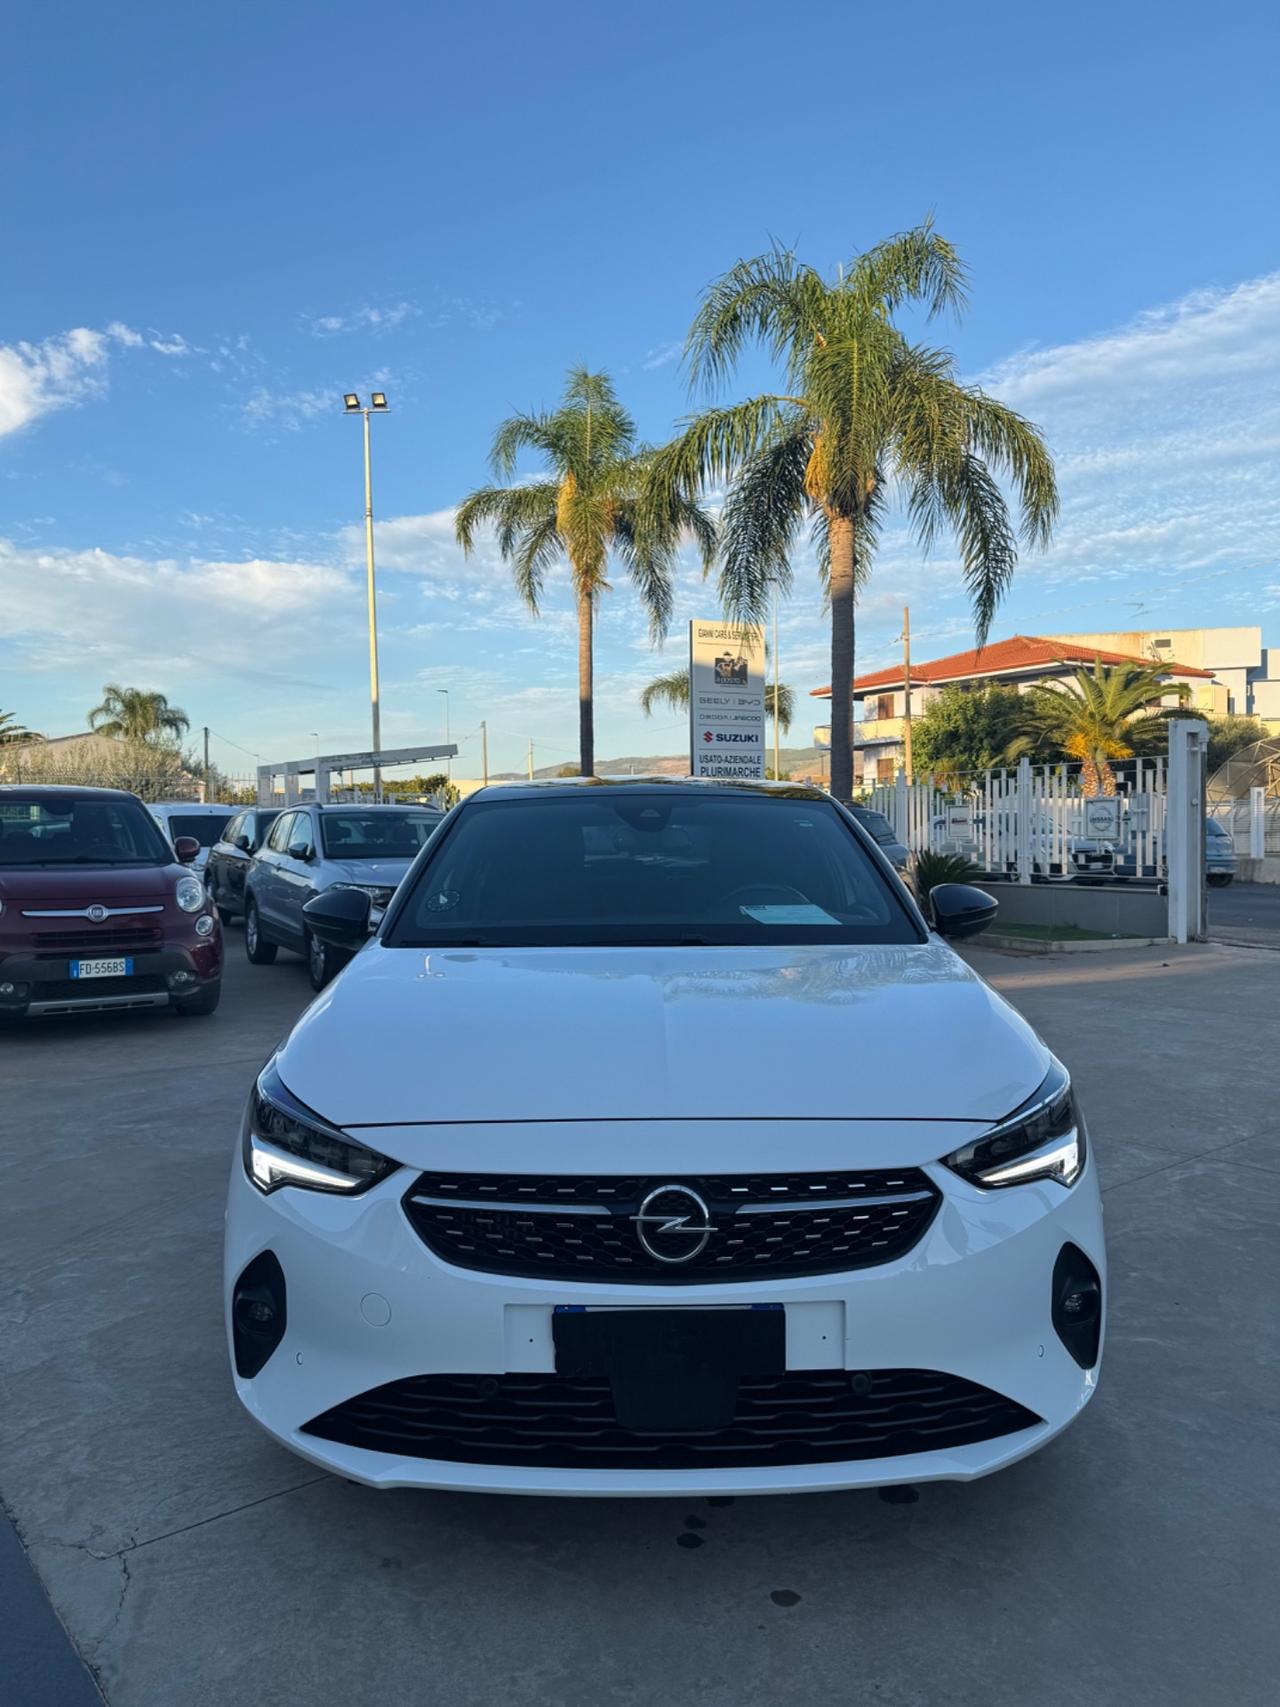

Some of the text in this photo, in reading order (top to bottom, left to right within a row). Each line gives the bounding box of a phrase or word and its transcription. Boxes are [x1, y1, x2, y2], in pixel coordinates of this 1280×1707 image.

[715, 630, 727, 639] CARS
[716, 734, 758, 742] SUZUKI
[700, 766, 761, 777] PLURIMARCHE
